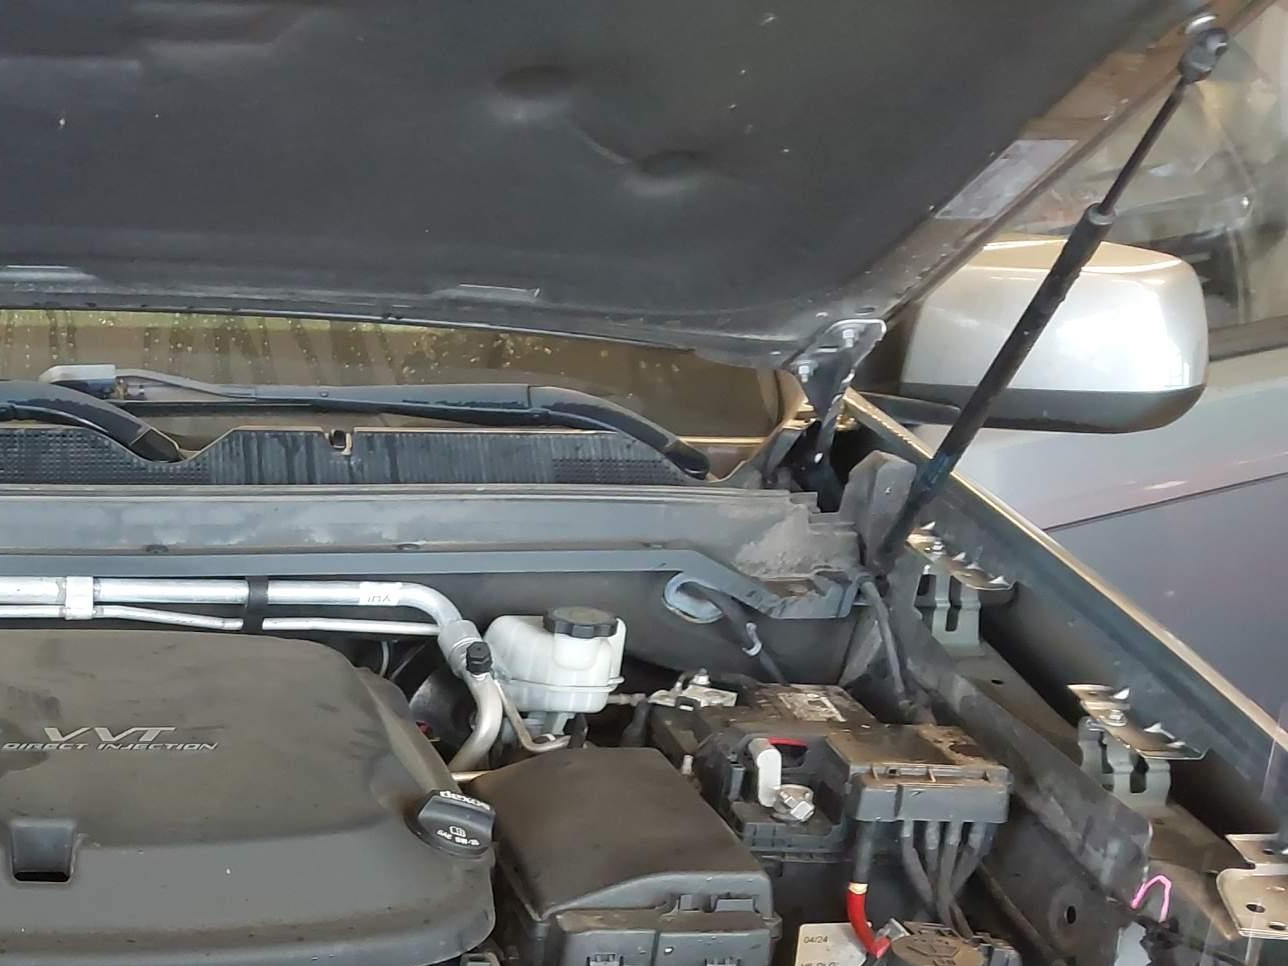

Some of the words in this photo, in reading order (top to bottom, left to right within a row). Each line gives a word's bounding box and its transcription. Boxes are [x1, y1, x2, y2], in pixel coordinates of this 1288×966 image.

[44, 726, 178, 743] VVT
[0, 742, 89, 752] DIRECT
[97, 742, 219, 752] INJECTION
